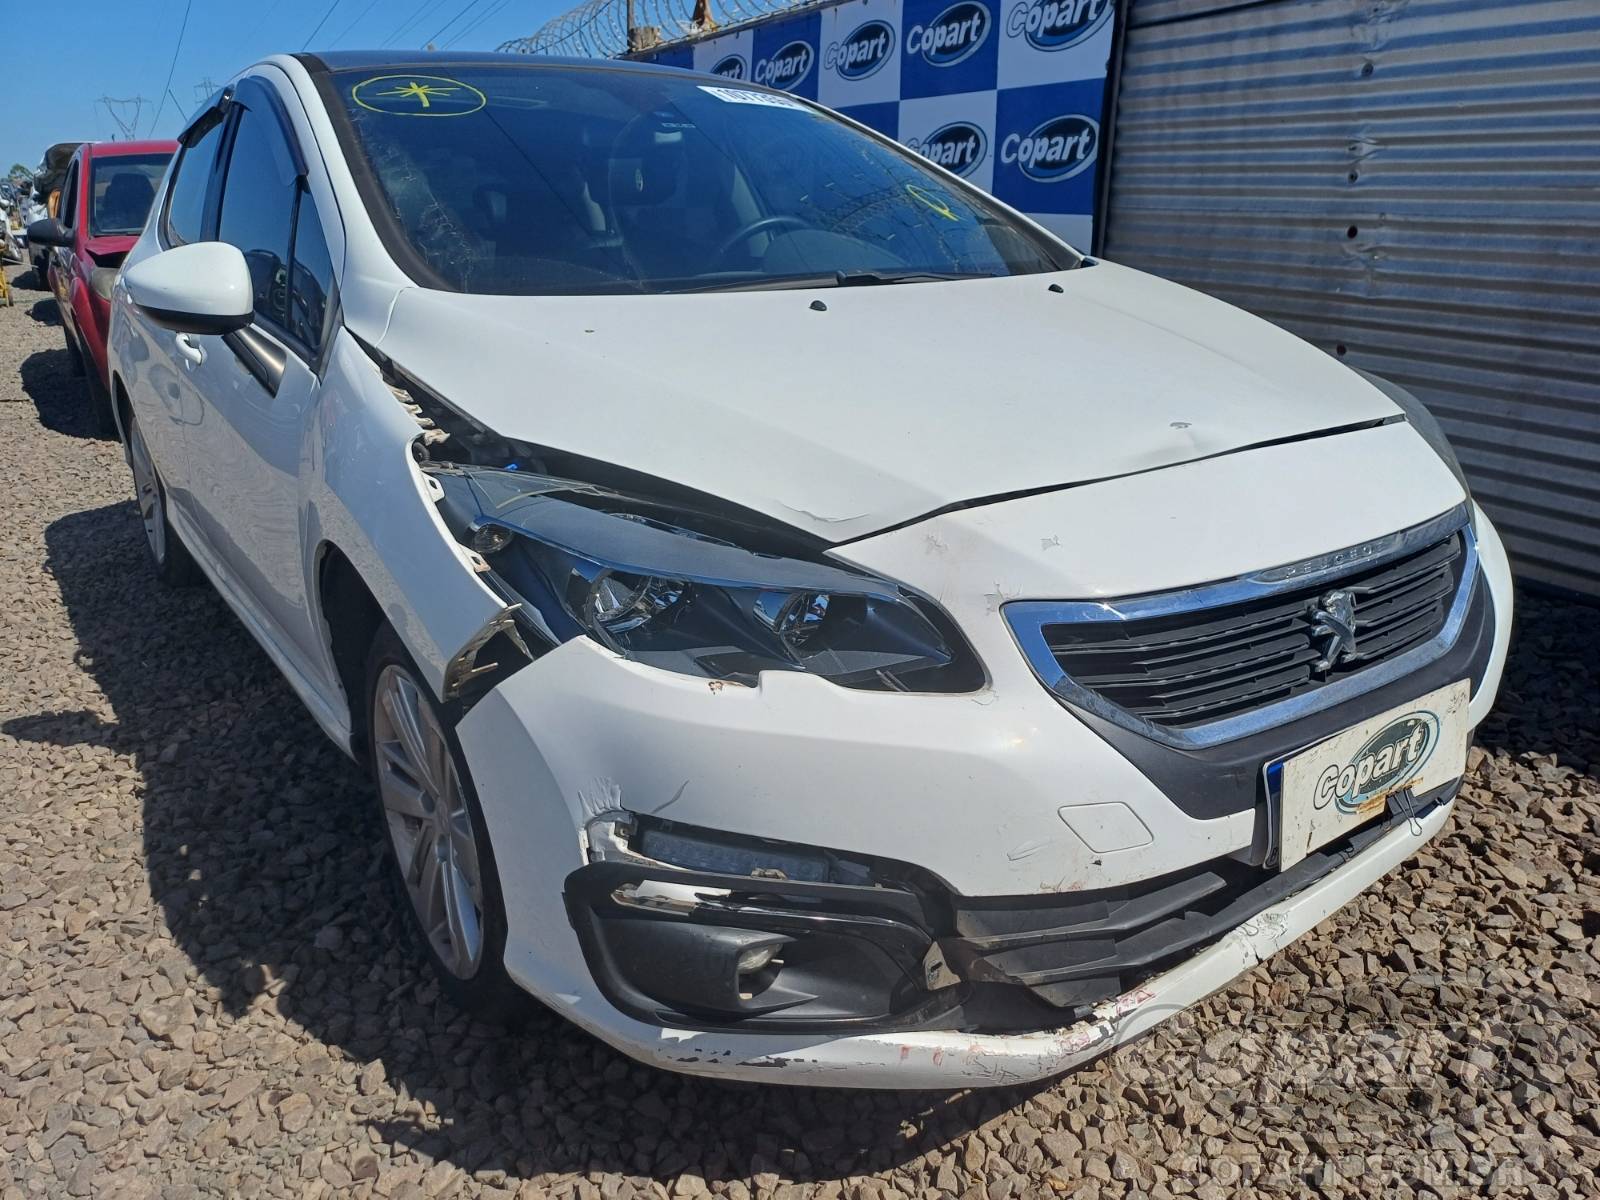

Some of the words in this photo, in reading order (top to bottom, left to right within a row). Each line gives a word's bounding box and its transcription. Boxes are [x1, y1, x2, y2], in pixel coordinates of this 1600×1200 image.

[824, 32, 886, 71] Copart
[906, 12, 981, 55] Copart
[755, 49, 807, 83] Copart
[1000, 128, 1091, 168] Copart
[1313, 723, 1426, 810] Copart
